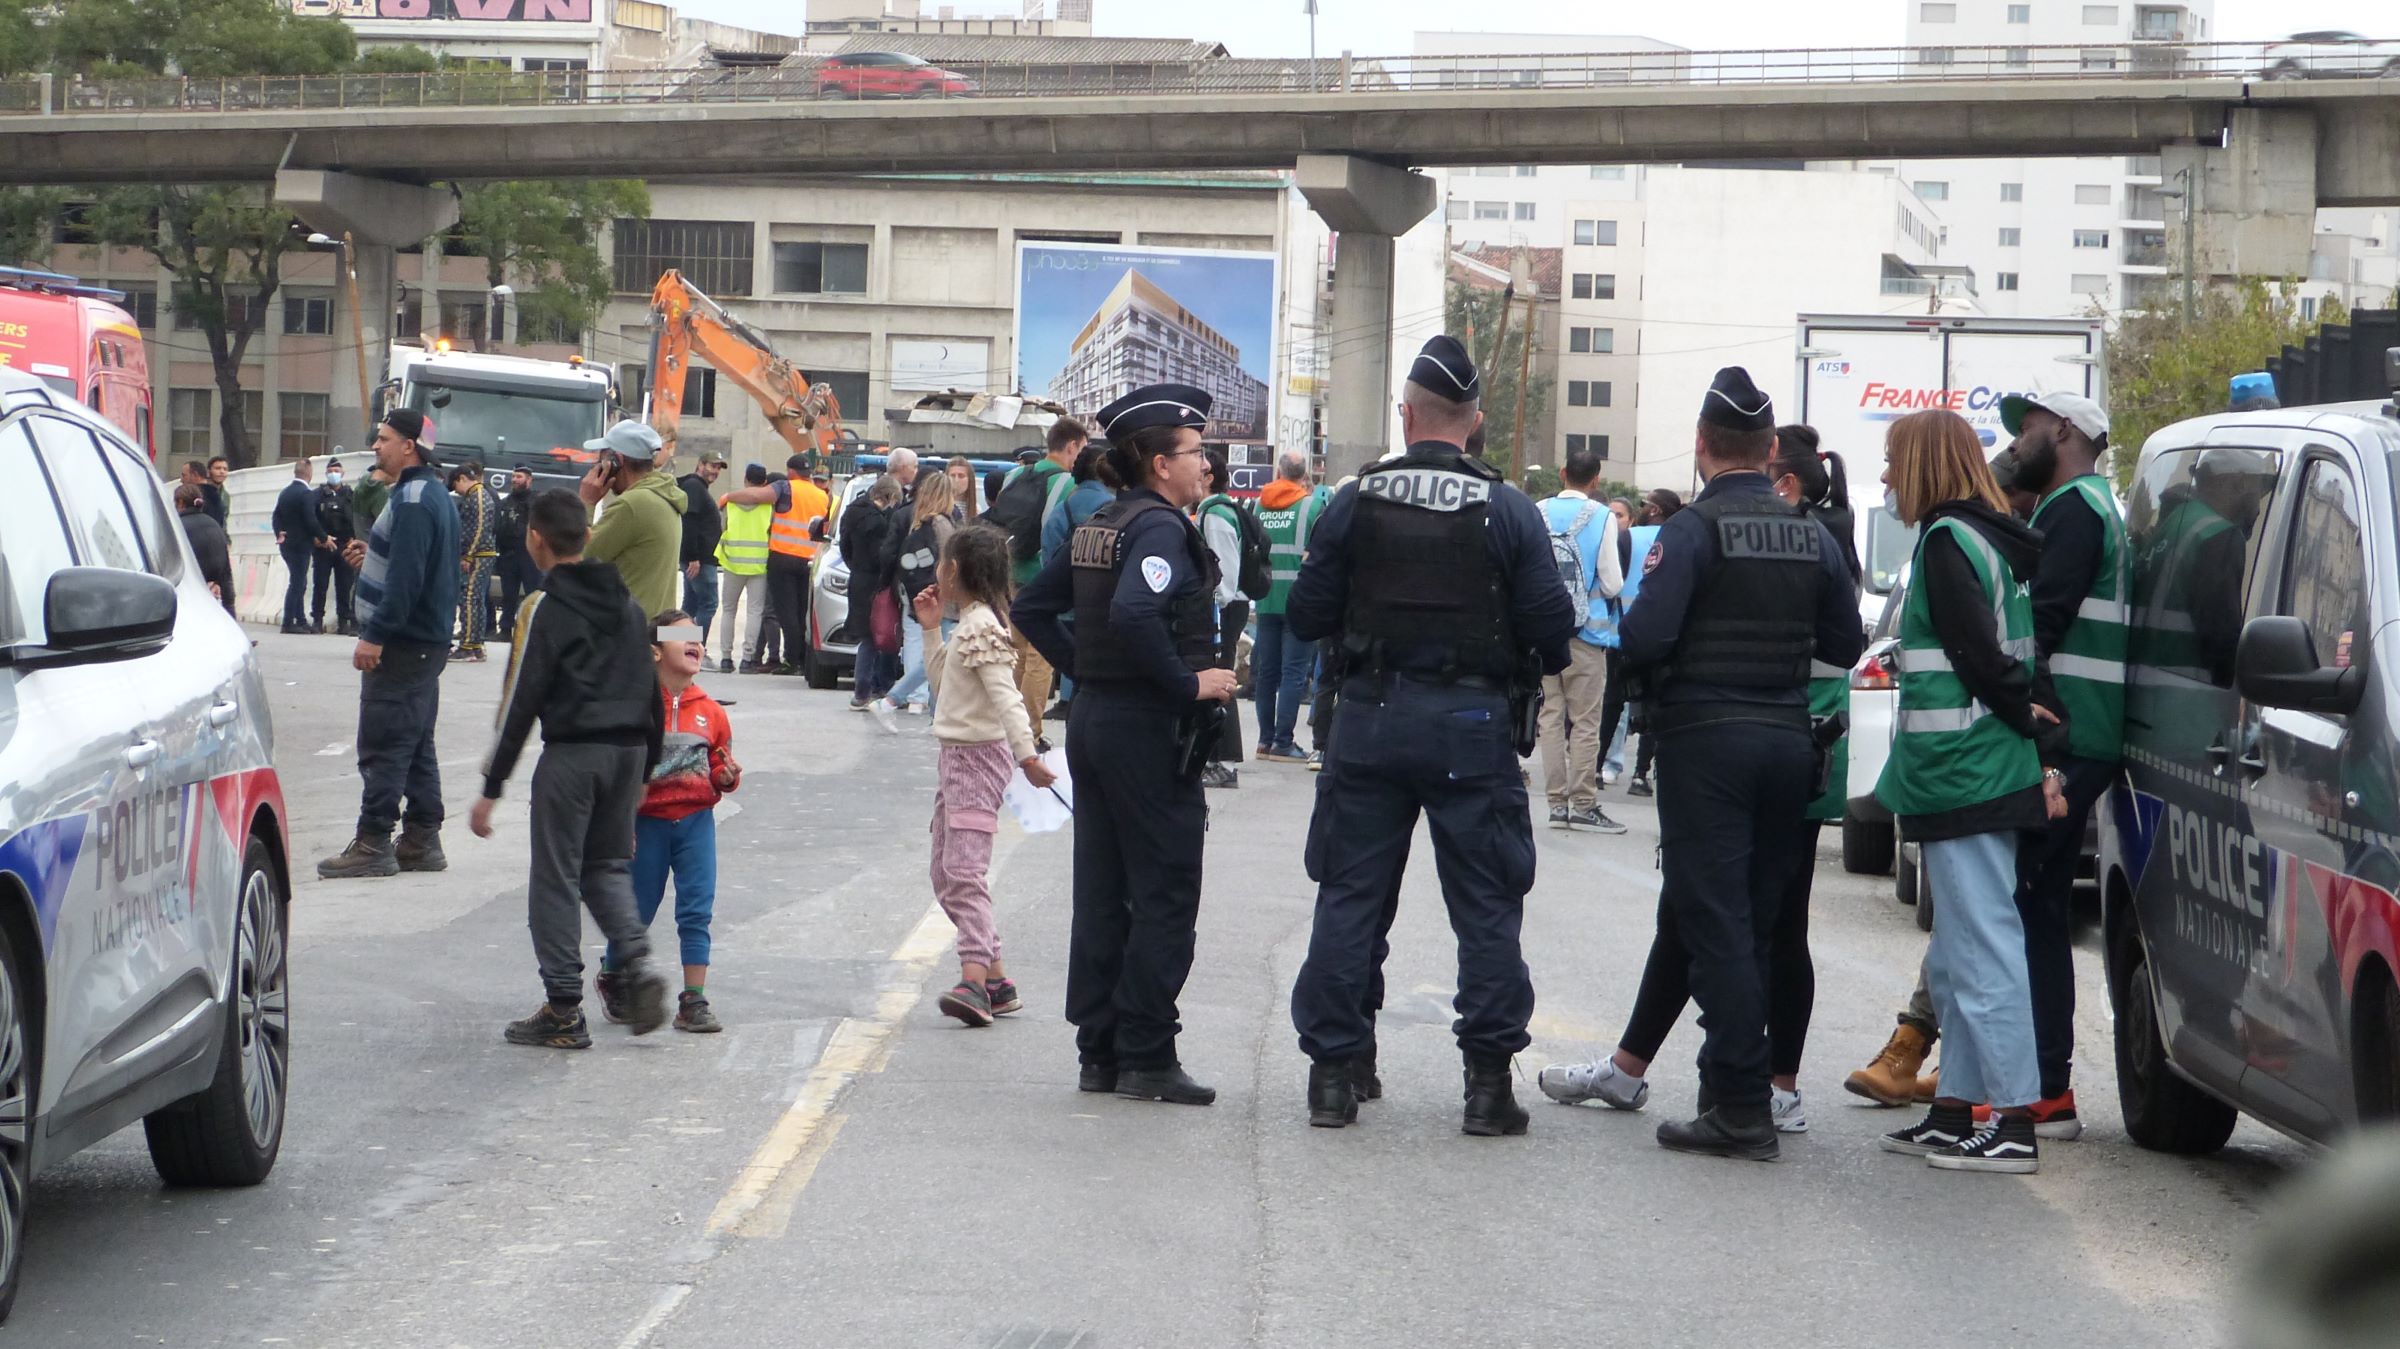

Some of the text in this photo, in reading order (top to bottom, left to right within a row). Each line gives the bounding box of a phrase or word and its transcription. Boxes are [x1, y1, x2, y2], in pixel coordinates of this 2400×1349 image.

[1817, 362, 1840, 372] ATS
[1367, 473, 1481, 507] POLICE
[1260, 511, 1295, 521] GROUPE
[1072, 528, 1116, 565] OLICE
[1723, 522, 1818, 555] POLICE
[95, 785, 178, 891] POLICE
[2168, 803, 2264, 918] POLICE
[92, 880, 184, 955] NATIONALE
[2175, 893, 2270, 979] NATIONALE
